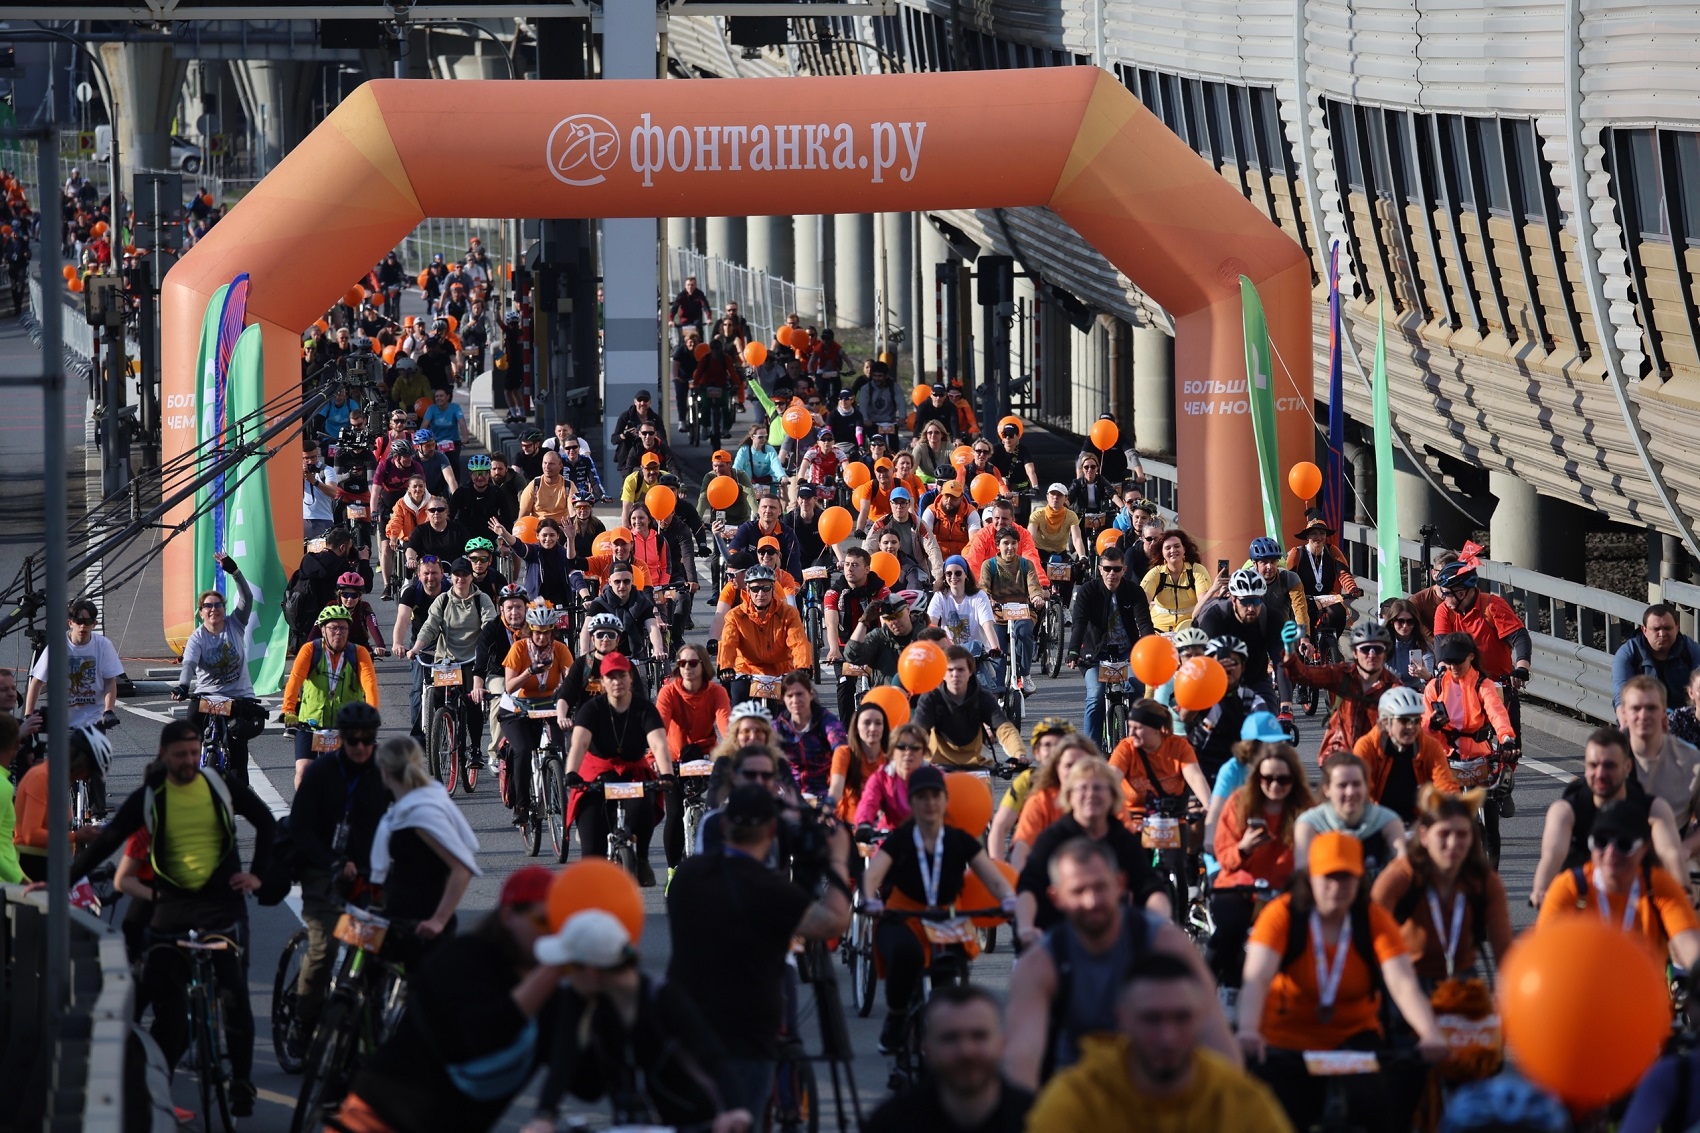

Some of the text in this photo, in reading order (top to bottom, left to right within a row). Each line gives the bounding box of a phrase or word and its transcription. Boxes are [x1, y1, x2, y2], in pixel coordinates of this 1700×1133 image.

[630, 113, 927, 187] фонтанка.ру
[1184, 380, 1250, 394] БОЛЬШ
[167, 393, 196, 409] БОЛ
[1184, 397, 1305, 415] ЧЕМ НОСТИ
[167, 415, 196, 429] ЧЕМ
[438, 672, 457, 680] 5954
